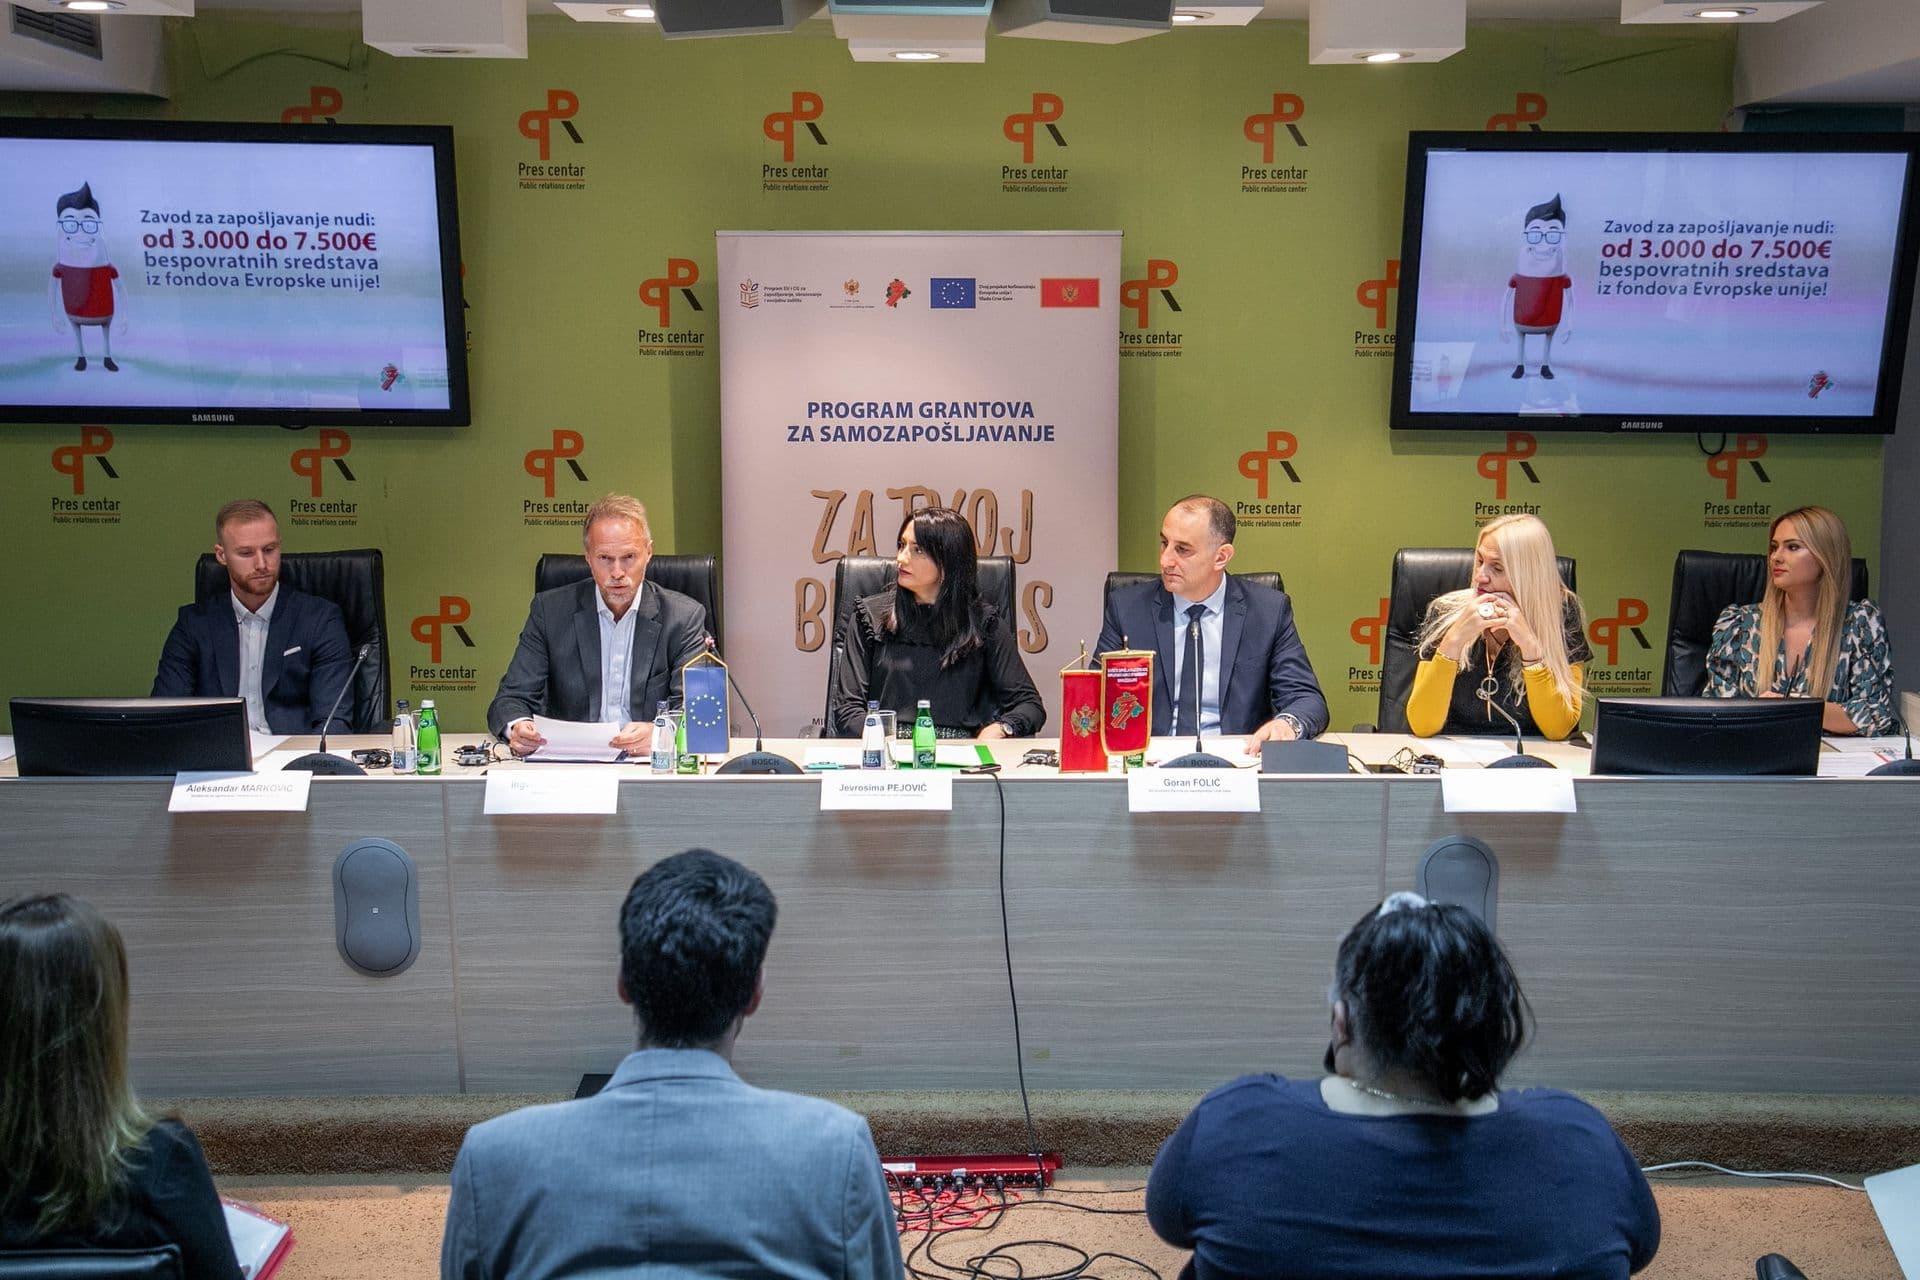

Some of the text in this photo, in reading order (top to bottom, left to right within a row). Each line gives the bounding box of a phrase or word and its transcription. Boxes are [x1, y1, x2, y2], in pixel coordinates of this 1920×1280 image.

[518, 161, 585, 177] Pres centar
[762, 163, 830, 179] Pres centar
[1002, 165, 1068, 181] Pres centar
[1241, 165, 1308, 181] Pres centar
[140, 210, 376, 229] Zavod za zapošljavanje nudi:
[1604, 220, 1834, 237] Zavod za zapošljavanje nudi:
[143, 228, 377, 251] od 3.000 do 7.500€
[1602, 238, 1832, 258] od 3.000 do 7.500€
[145, 251, 379, 272] bespovratnih sredstava
[1600, 260, 1829, 280] bespovratnih sredstava
[146, 272, 380, 292] iz fondova Evropske unije!
[1597, 280, 1827, 299] iz fondova Evropske unije!
[638, 329, 706, 345] Pres centar
[1119, 330, 1183, 345] Pres centar
[1354, 330, 1380, 345] Pres
[191, 414, 235, 422] SAMSUNG
[807, 401, 1035, 419] PROGRAM GRANTOVA
[787, 421, 1055, 442] ZA SAMOZAPOŠLJAVANJE
[1620, 421, 1664, 429] SAMSUNG
[52, 497, 119, 513] Pres centar
[290, 499, 358, 515] Pres centar
[524, 499, 590, 514] Pres centar
[1236, 501, 1304, 517] Pres centar
[1474, 501, 1542, 516] Pres centar
[1704, 501, 1771, 517] Pres centar
[570, 518, 584, 527] cent
[810, 486, 1034, 564] ZA TOJ
[410, 665, 478, 681] Pres centar
[1348, 666, 1374, 680] Pres
[1614, 667, 1652, 681] centar
[186, 784, 238, 793] Aleksandar
[840, 781, 928, 792] Jevrosima PEJOVIĆ
[1163, 778, 1190, 787] Goran
